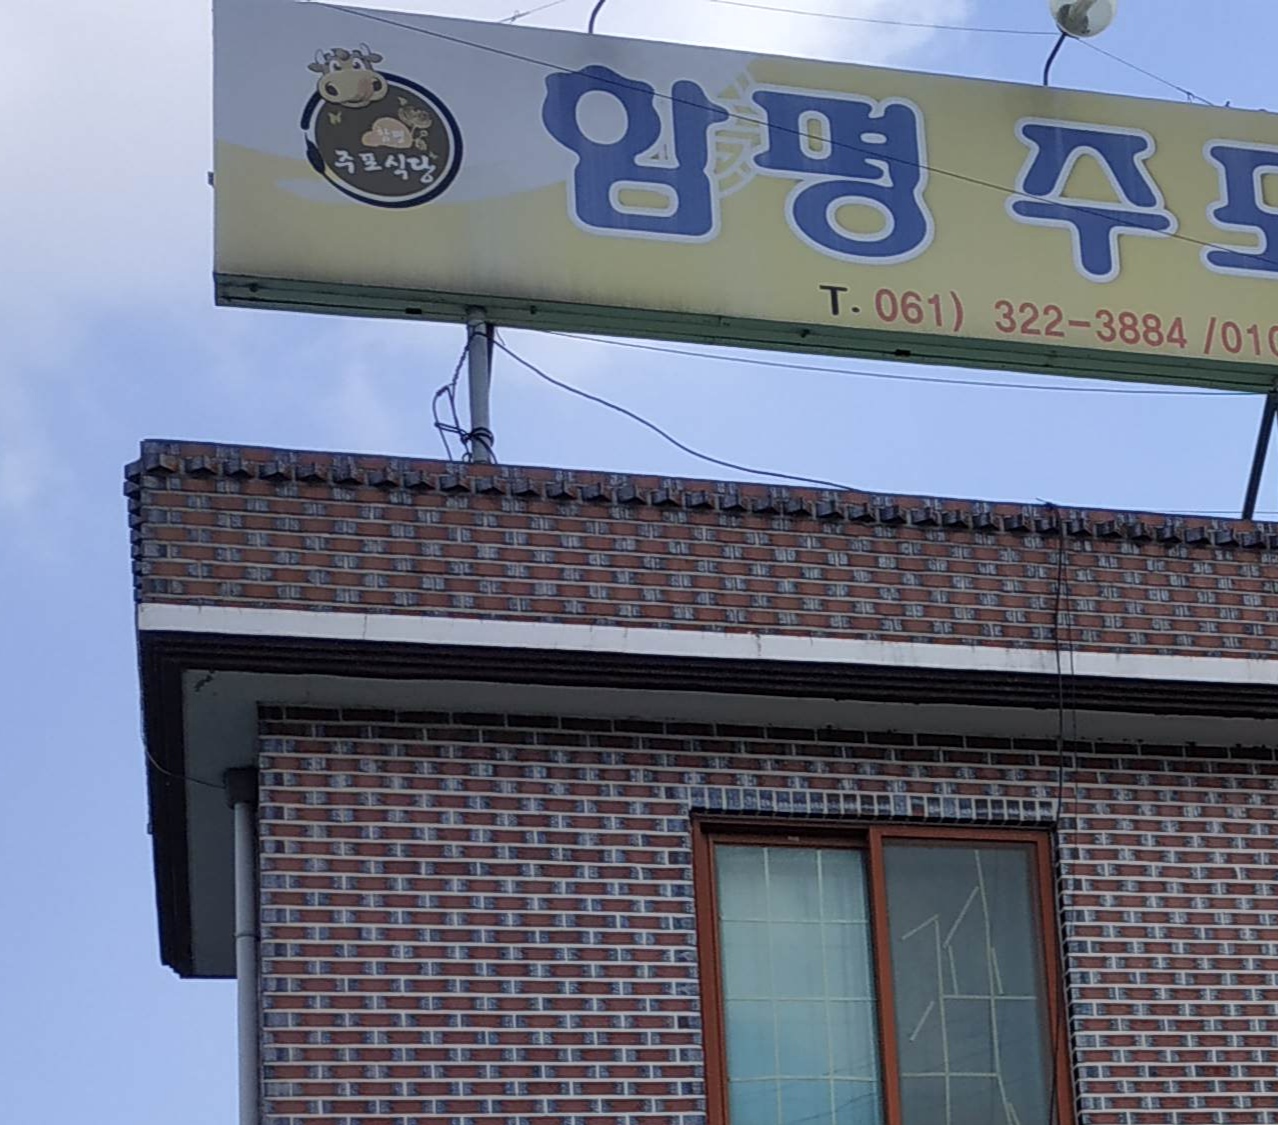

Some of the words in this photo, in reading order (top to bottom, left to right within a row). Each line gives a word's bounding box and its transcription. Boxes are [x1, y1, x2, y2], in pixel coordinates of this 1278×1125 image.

[333, 149, 437, 184] 주포식당
[819, 285, 861, 315] T.
[875, 289, 965, 333] 061)
[994, 299, 1188, 349] 322-3884
